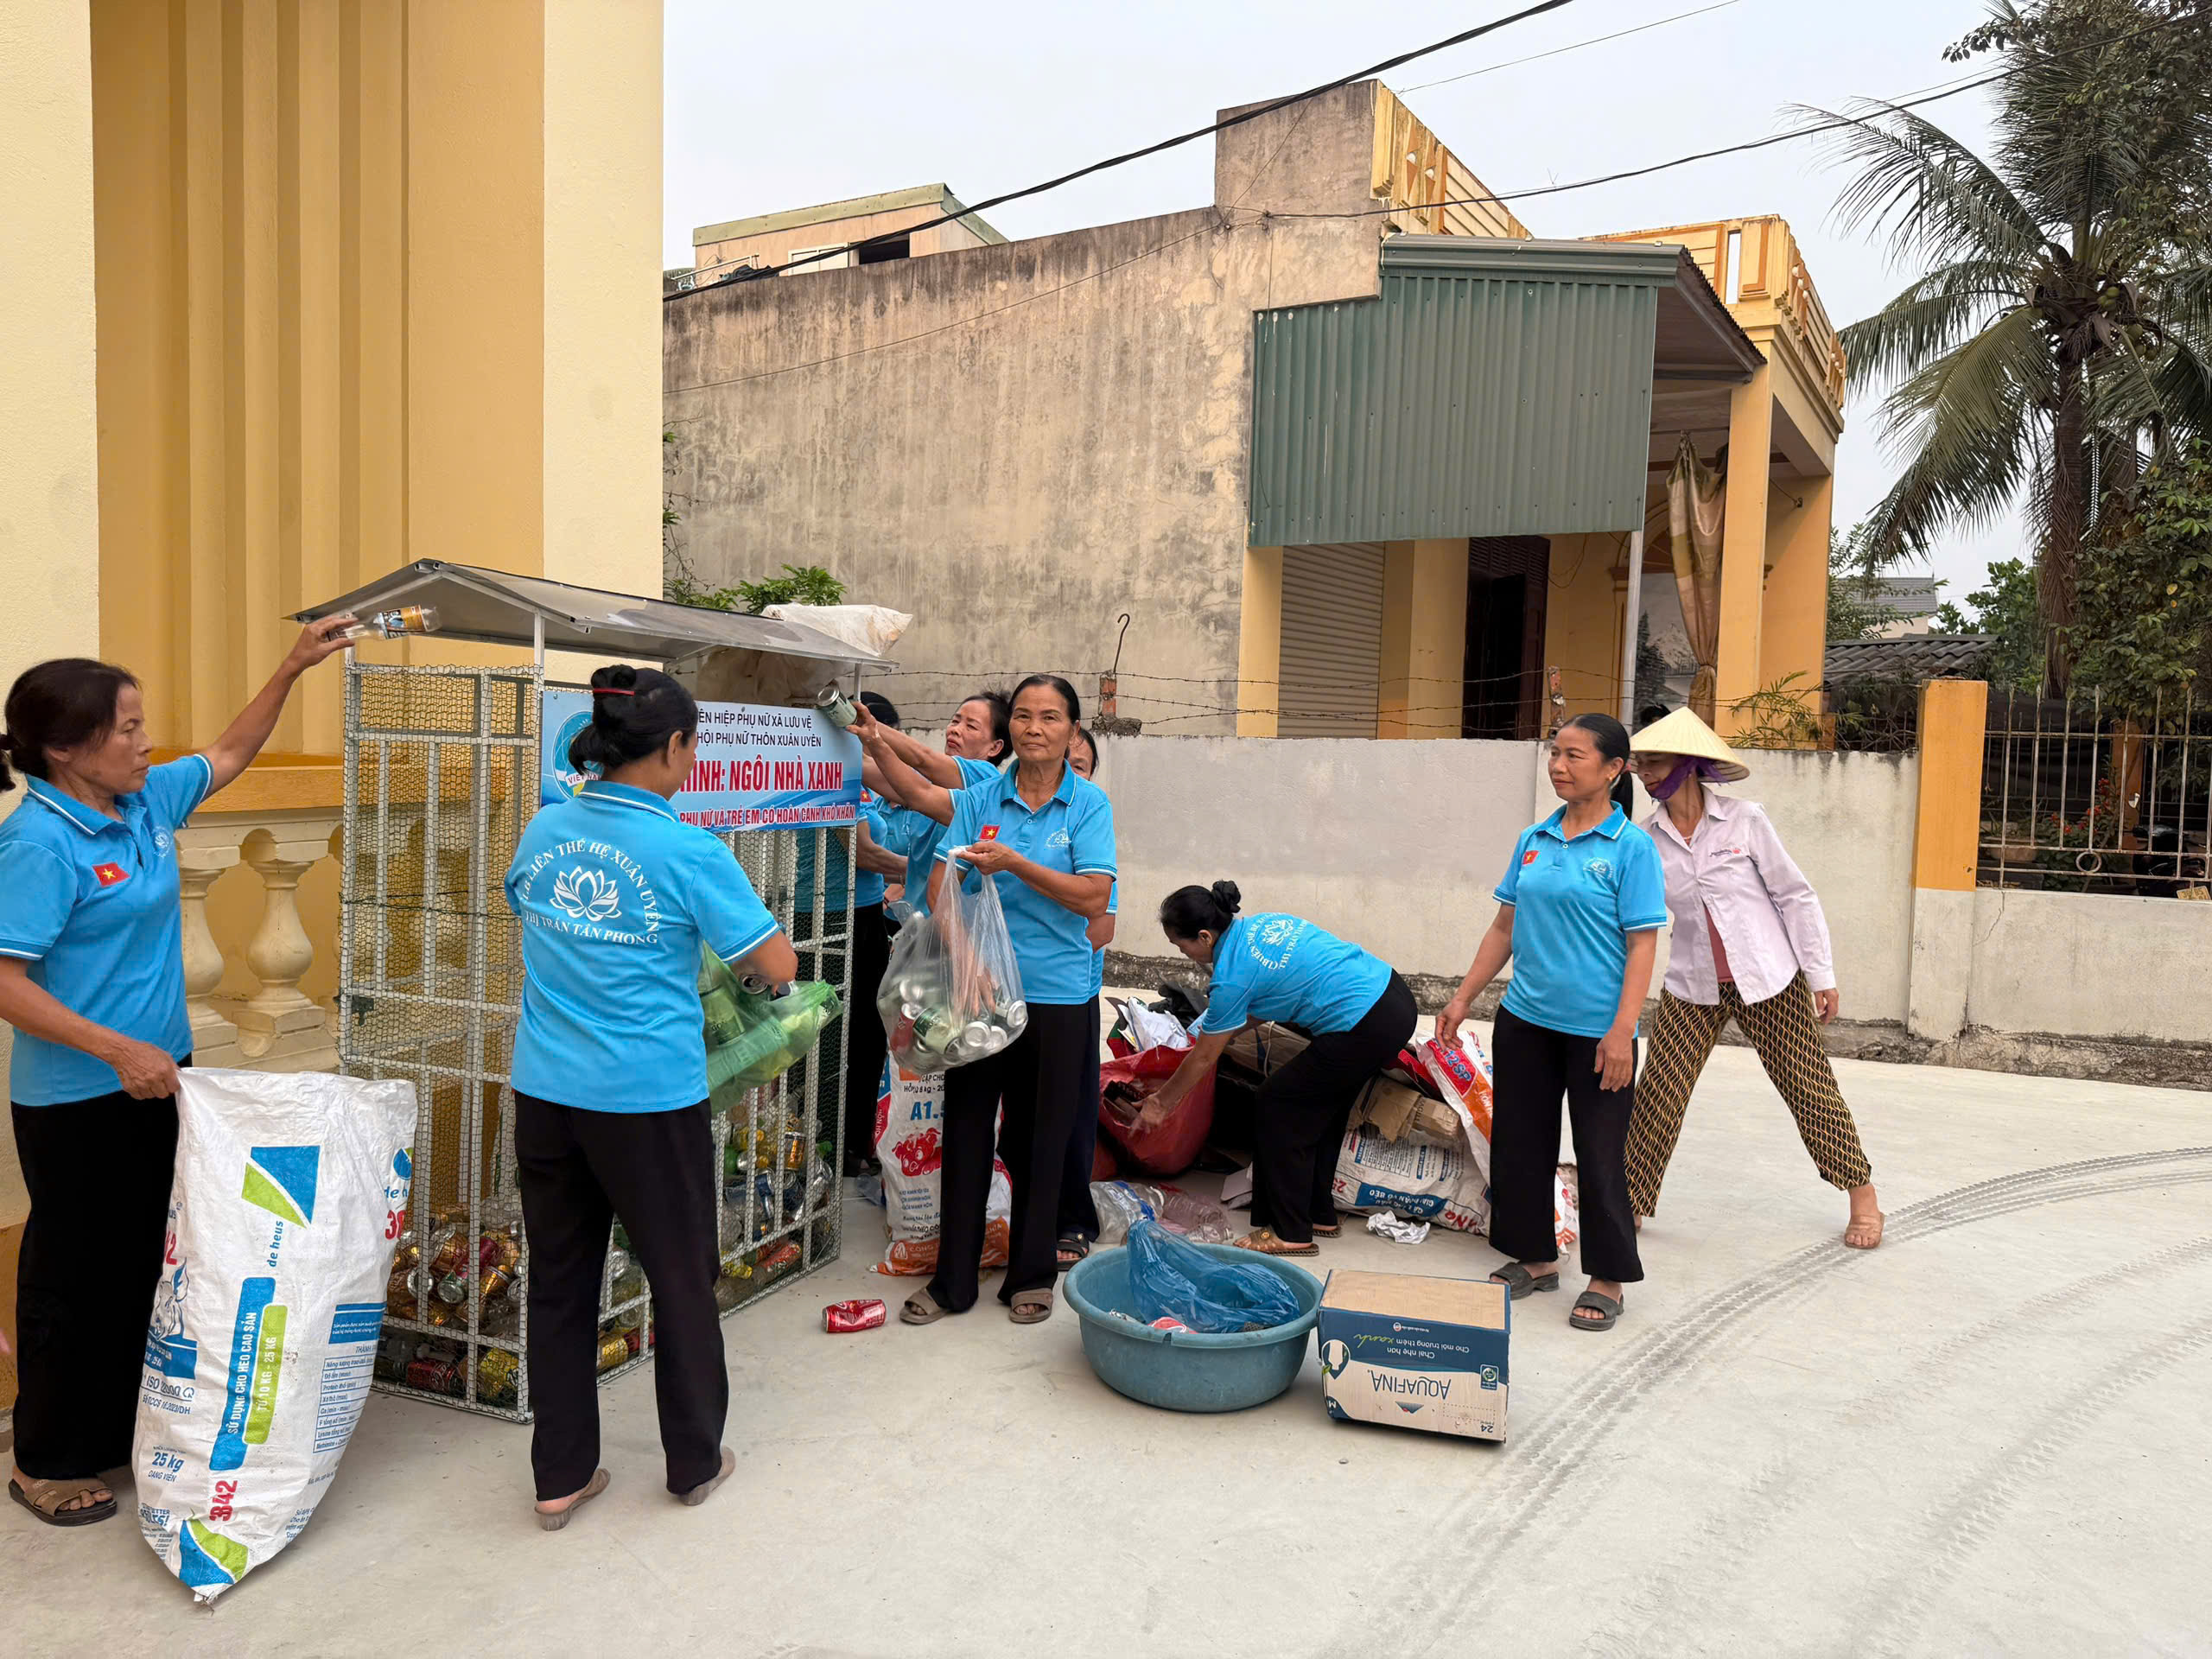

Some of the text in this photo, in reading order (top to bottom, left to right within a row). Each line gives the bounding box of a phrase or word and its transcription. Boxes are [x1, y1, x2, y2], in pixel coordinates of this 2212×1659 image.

[698, 708, 813, 732] ÊN HIỆP PHỤ NỮ XÃ LƯU VỆ
[715, 732, 735, 748] PHỤ
[736, 730, 750, 746] NỮ
[751, 731, 777, 747] THÔN
[777, 732, 800, 747] XUÂN
[801, 733, 823, 748] UYÊN
[680, 753, 844, 792] ÌNH: NGÔI NHÀ XANH
[701, 808, 715, 828] NỮ
[715, 809, 726, 827] VÀ
[745, 808, 761, 825] EM
[762, 804, 776, 824] CÓ
[776, 805, 800, 823] HOÀN
[528, 848, 555, 880] LIÊN
[555, 837, 586, 857] THẾ
[588, 842, 612, 860] HỆ
[610, 849, 648, 889] XUÂN
[639, 888, 663, 932] UYÊN
[573, 922, 603, 939] TÂN
[603, 929, 658, 945] PHONG
[910, 1100, 944, 1121] A1.
[268, 1219, 285, 1268] de heus
[265, 1336, 277, 1352] KG
[1353, 1333, 1395, 1349] xanh
[1395, 1338, 1416, 1347] thêm
[1455, 1344, 1470, 1354] Cho
[264, 1351, 276, 1363] 25
[1402, 1347, 1417, 1357] nhẹ
[1419, 1350, 1435, 1359] Chai
[146, 1374, 160, 1390] ISO
[226, 1312, 257, 1434] SỬ DỤNG CHO HEO CAO SẢN
[261, 1370, 273, 1384] KG
[259, 1386, 271, 1397] 10
[1370, 1370, 1452, 1400] AQUAFINA
[1480, 1424, 1494, 1433] 24
[151, 1452, 185, 1473] 25 kg
[209, 1480, 238, 1522] 342
